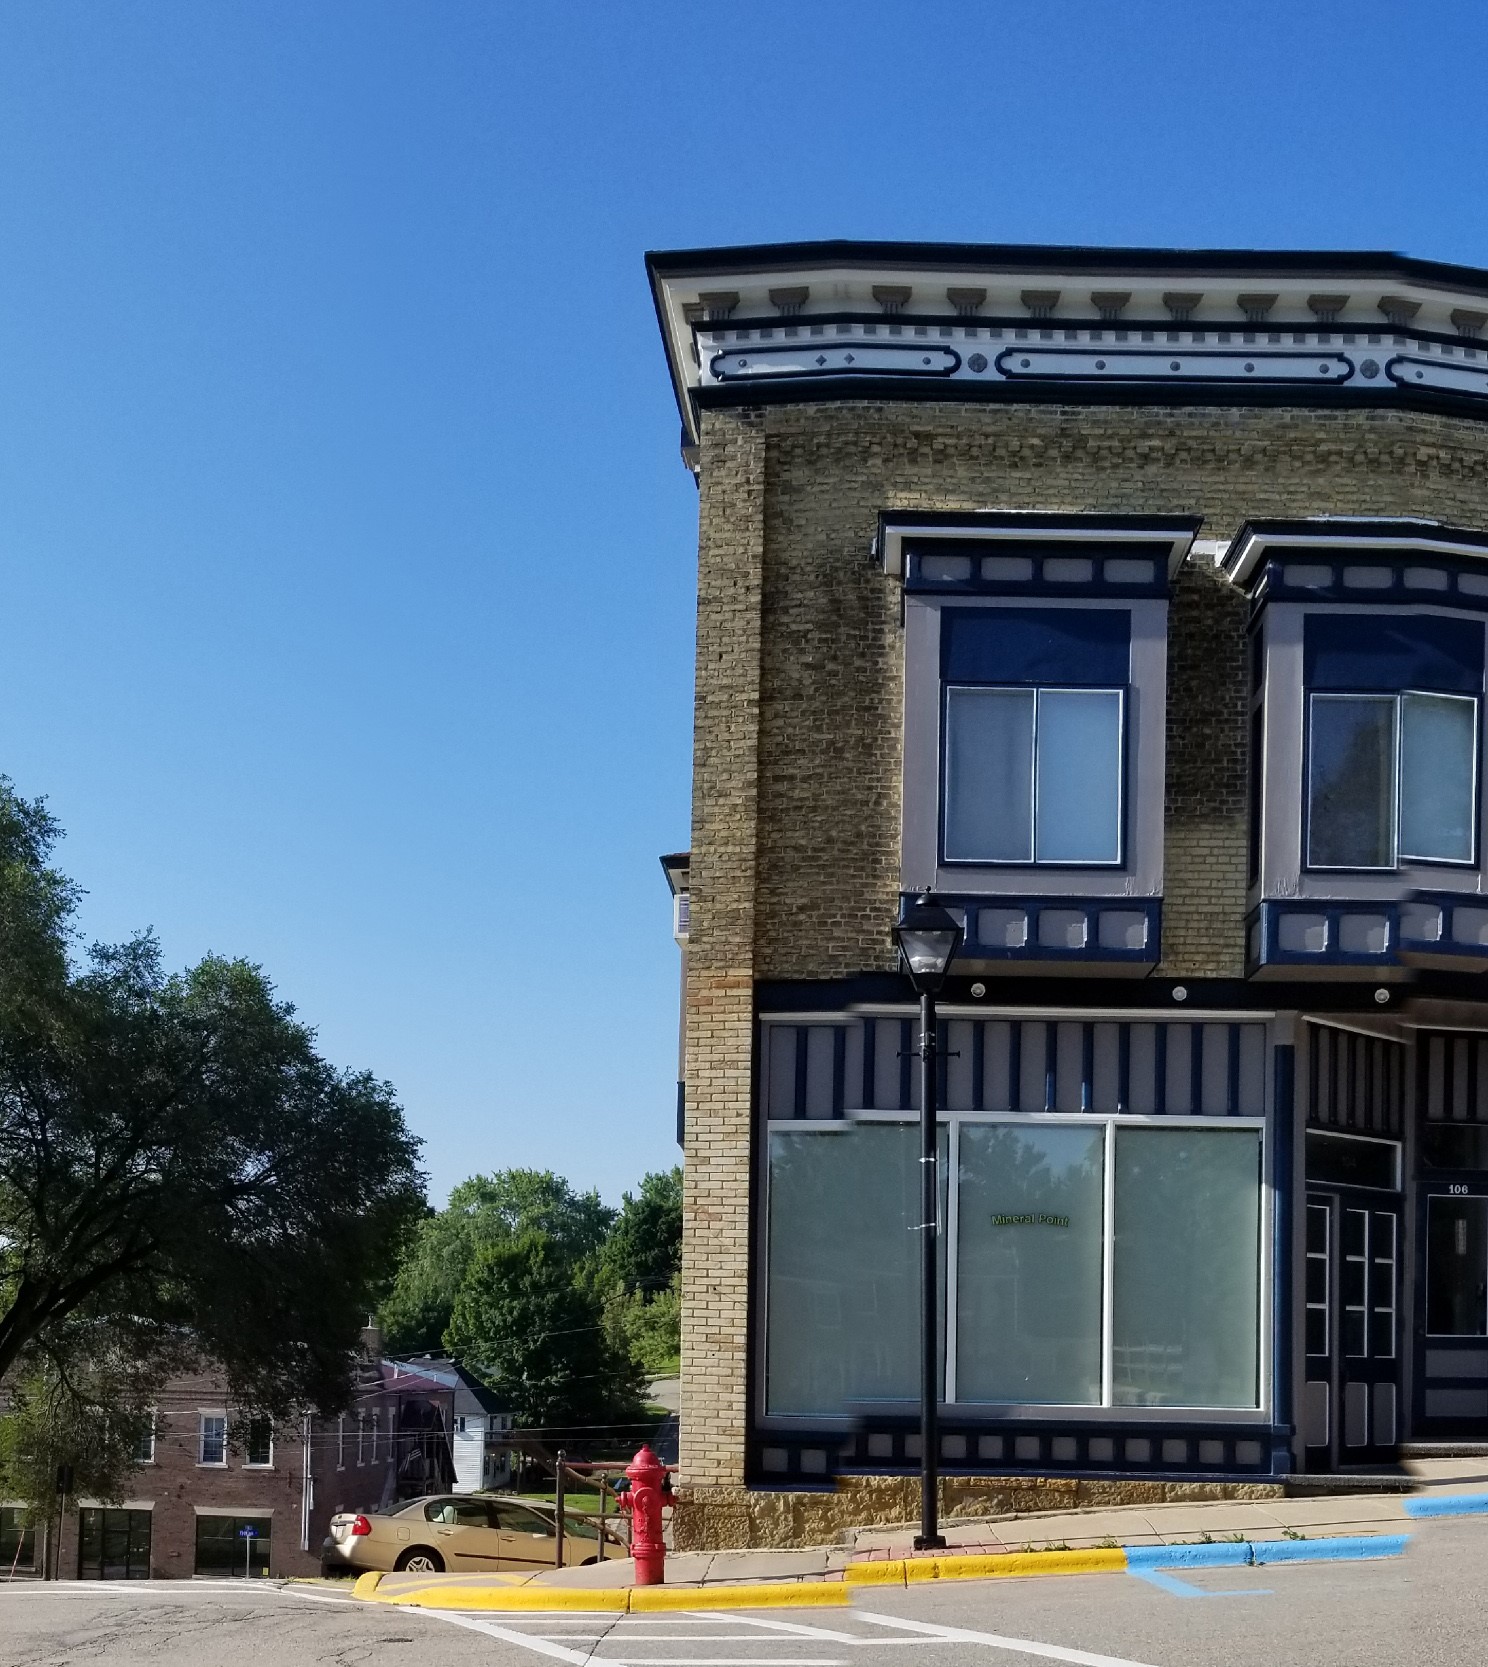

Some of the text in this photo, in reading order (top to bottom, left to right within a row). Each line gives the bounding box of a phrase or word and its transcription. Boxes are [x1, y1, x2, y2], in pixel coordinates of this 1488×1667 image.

[1448, 1184, 1469, 1194] 106
[991, 1213, 1070, 1227] Mineral Point
